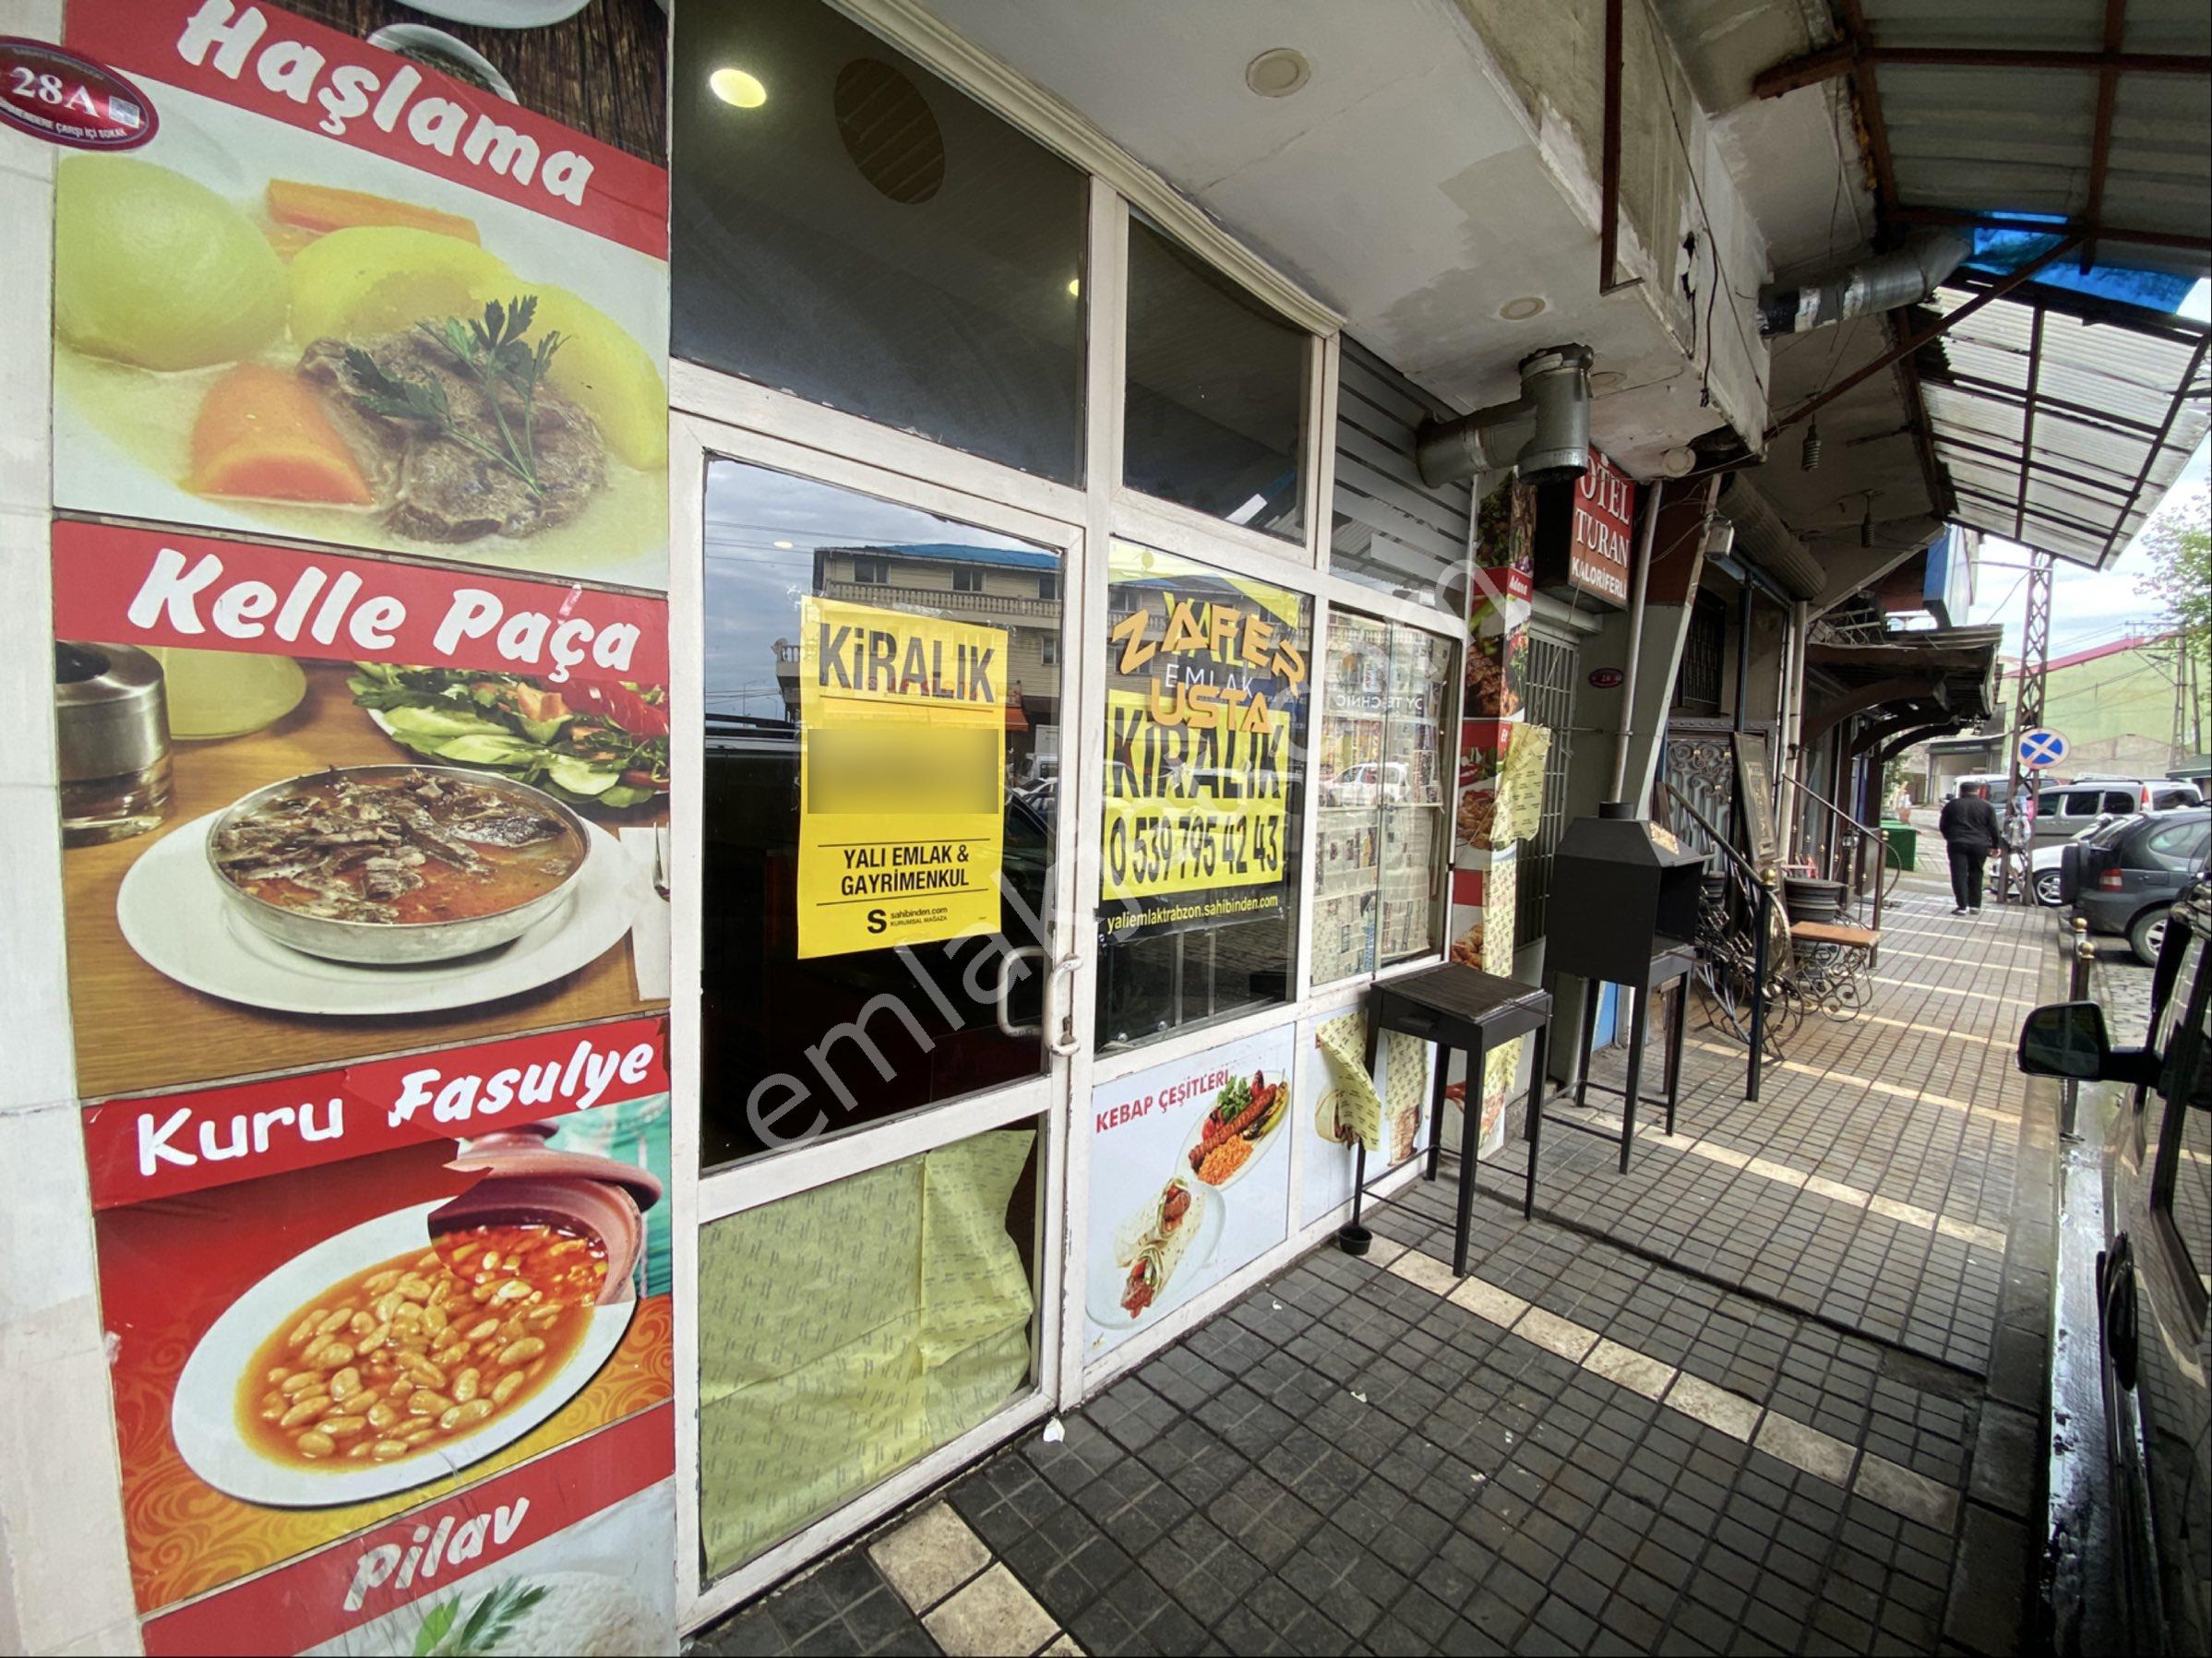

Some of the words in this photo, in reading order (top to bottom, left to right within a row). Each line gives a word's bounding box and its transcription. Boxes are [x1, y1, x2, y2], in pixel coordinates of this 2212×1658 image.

[9, 66, 101, 118] 28A
[177, 0, 594, 206] Haşlama
[1579, 455, 1630, 525] OTEL
[1575, 507, 1630, 567] TURAN
[127, 548, 406, 649] Kelle
[433, 589, 640, 682] Paça
[1111, 601, 1305, 699] ZAFER
[1150, 678, 1272, 734] USTA
[1165, 662, 1253, 698] EMLAK
[843, 848, 886, 869] YALI
[892, 845, 952, 866] EMLAK
[957, 844, 969, 863] &
[1110, 817, 1126, 886] 0
[1133, 816, 1172, 884] 539
[1178, 815, 1217, 879] 795
[1222, 815, 1248, 875] 42
[1253, 815, 1279, 872] 43
[842, 868, 969, 896] GAYRİMENKUL
[867, 909, 887, 934] S
[891, 907, 948, 919] sahibinden.com
[1107, 895, 1279, 935] yaliemlaktrabzon.sahibinden.com
[138, 1098, 343, 1176] Kuru
[389, 1040, 654, 1127] Fasulye
[1096, 1095, 1154, 1133] KEBAP
